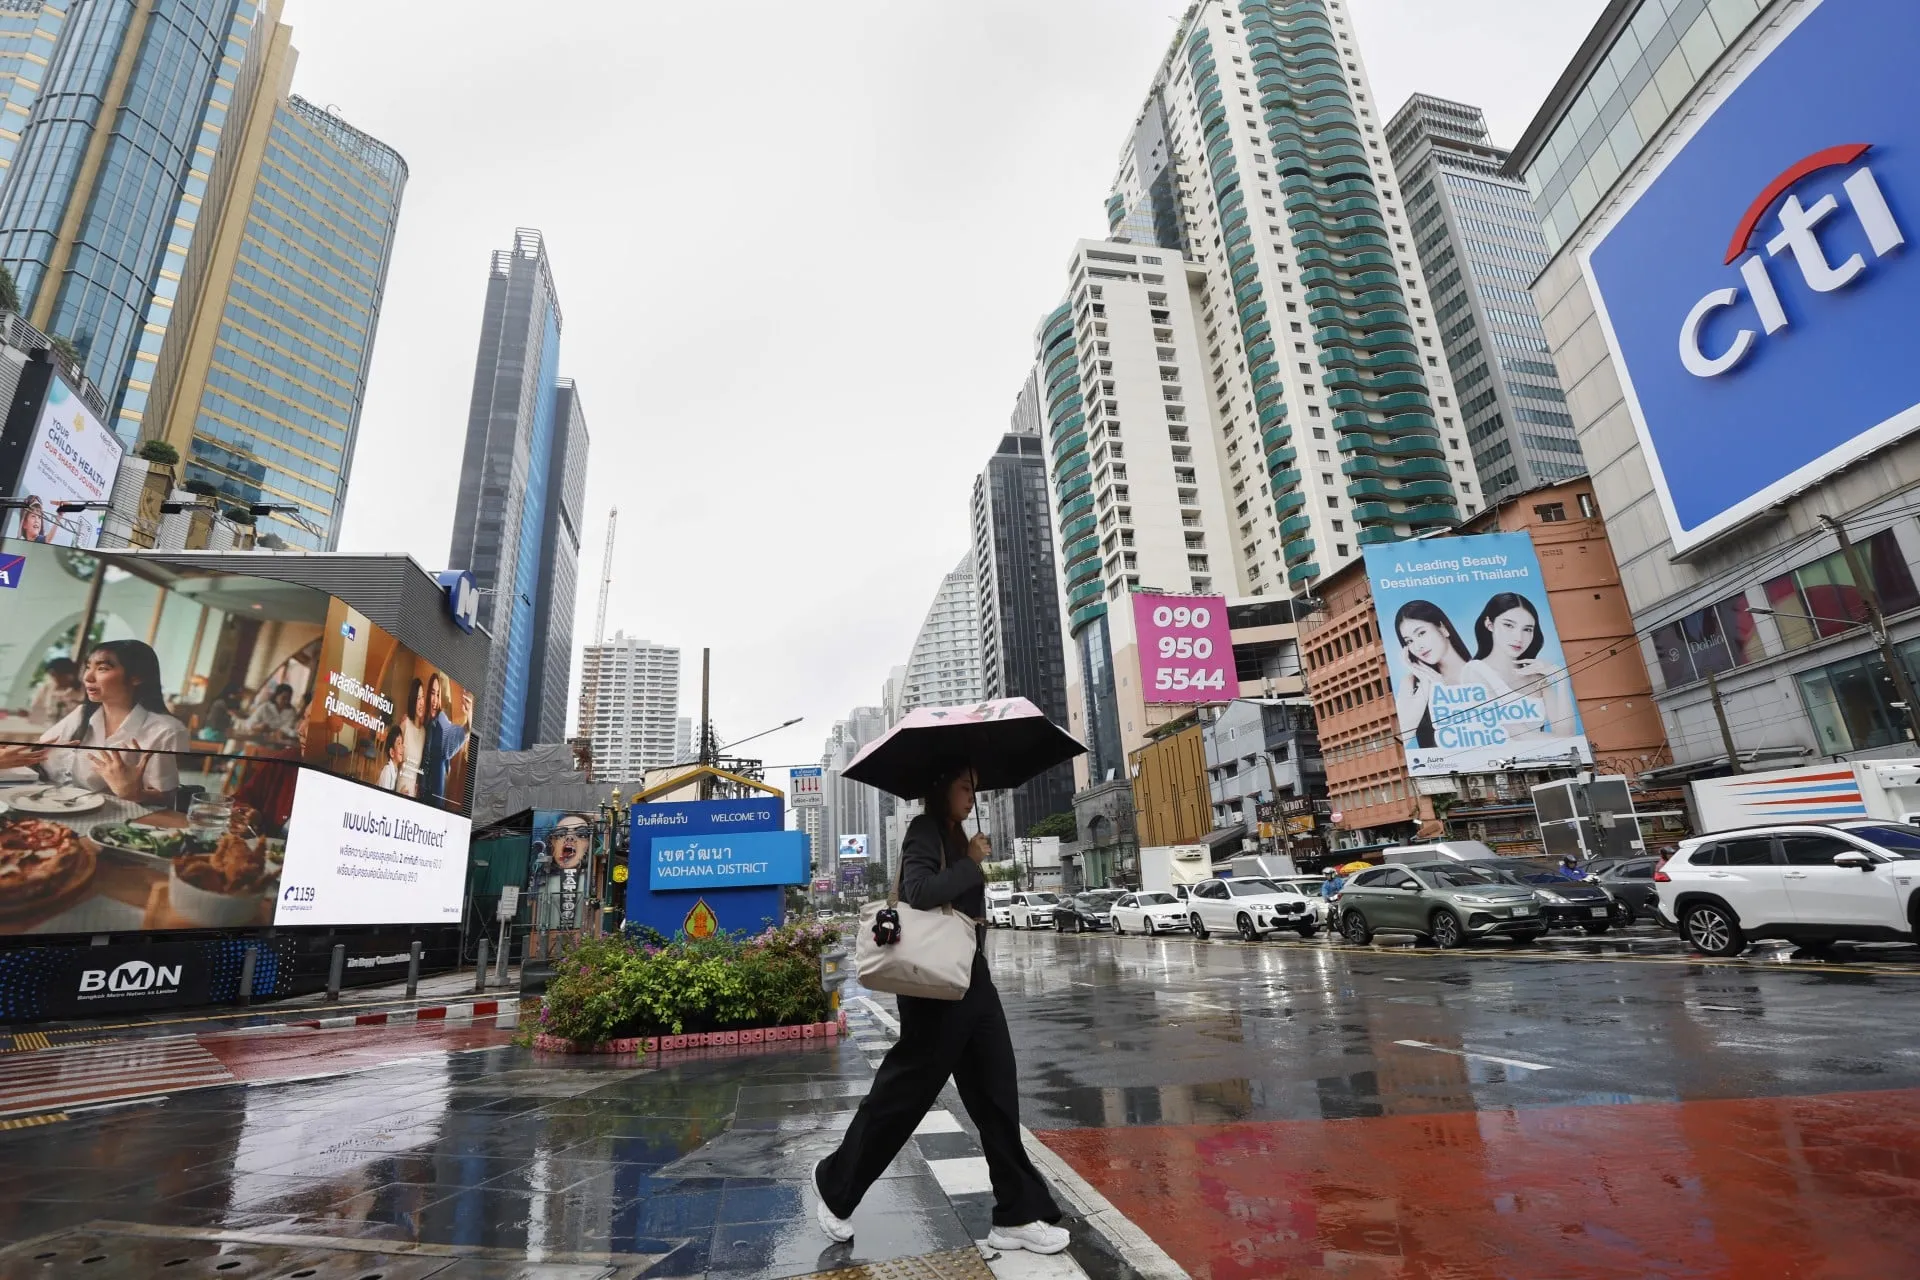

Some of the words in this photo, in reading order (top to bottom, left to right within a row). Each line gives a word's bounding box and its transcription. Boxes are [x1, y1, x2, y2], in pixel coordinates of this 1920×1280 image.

[1679, 166, 1905, 377] citi
[53, 417, 70, 439] YOUR
[45, 440, 58, 457] OUR
[58, 452, 79, 477] SHARED
[79, 474, 103, 498] JOURNEY
[48, 428, 78, 462] CHILD'S
[78, 456, 106, 489] HEALTH
[1395, 562, 1404, 573] A
[1407, 559, 1459, 572] Leading
[1462, 554, 1507, 567] Beauty
[1380, 574, 1454, 589] Destination
[1458, 571, 1469, 583] in
[1472, 566, 1528, 581] Thailand
[1153, 606, 1211, 628] 090
[1158, 636, 1213, 659] 950
[1155, 667, 1226, 690] 5544
[329, 670, 394, 715] พลัสชีวิตให้พร้อม
[1432, 685, 1487, 705] Aura
[324, 690, 385, 735] คุ้มครองสองเท่า
[1432, 698, 1540, 728] Bangkok
[1439, 726, 1506, 748] Clinic
[343, 810, 392, 837] แบบประกัน
[637, 812, 688, 826] ยินดีต้อนรับ
[711, 813, 755, 823] WELCOME
[757, 811, 771, 821] TO
[658, 843, 732, 862] เขตวัฒนา
[657, 865, 714, 877] VADHANA
[717, 862, 768, 875] DISTRICT
[293, 886, 315, 901] 1159
[79, 961, 182, 992] BMN
